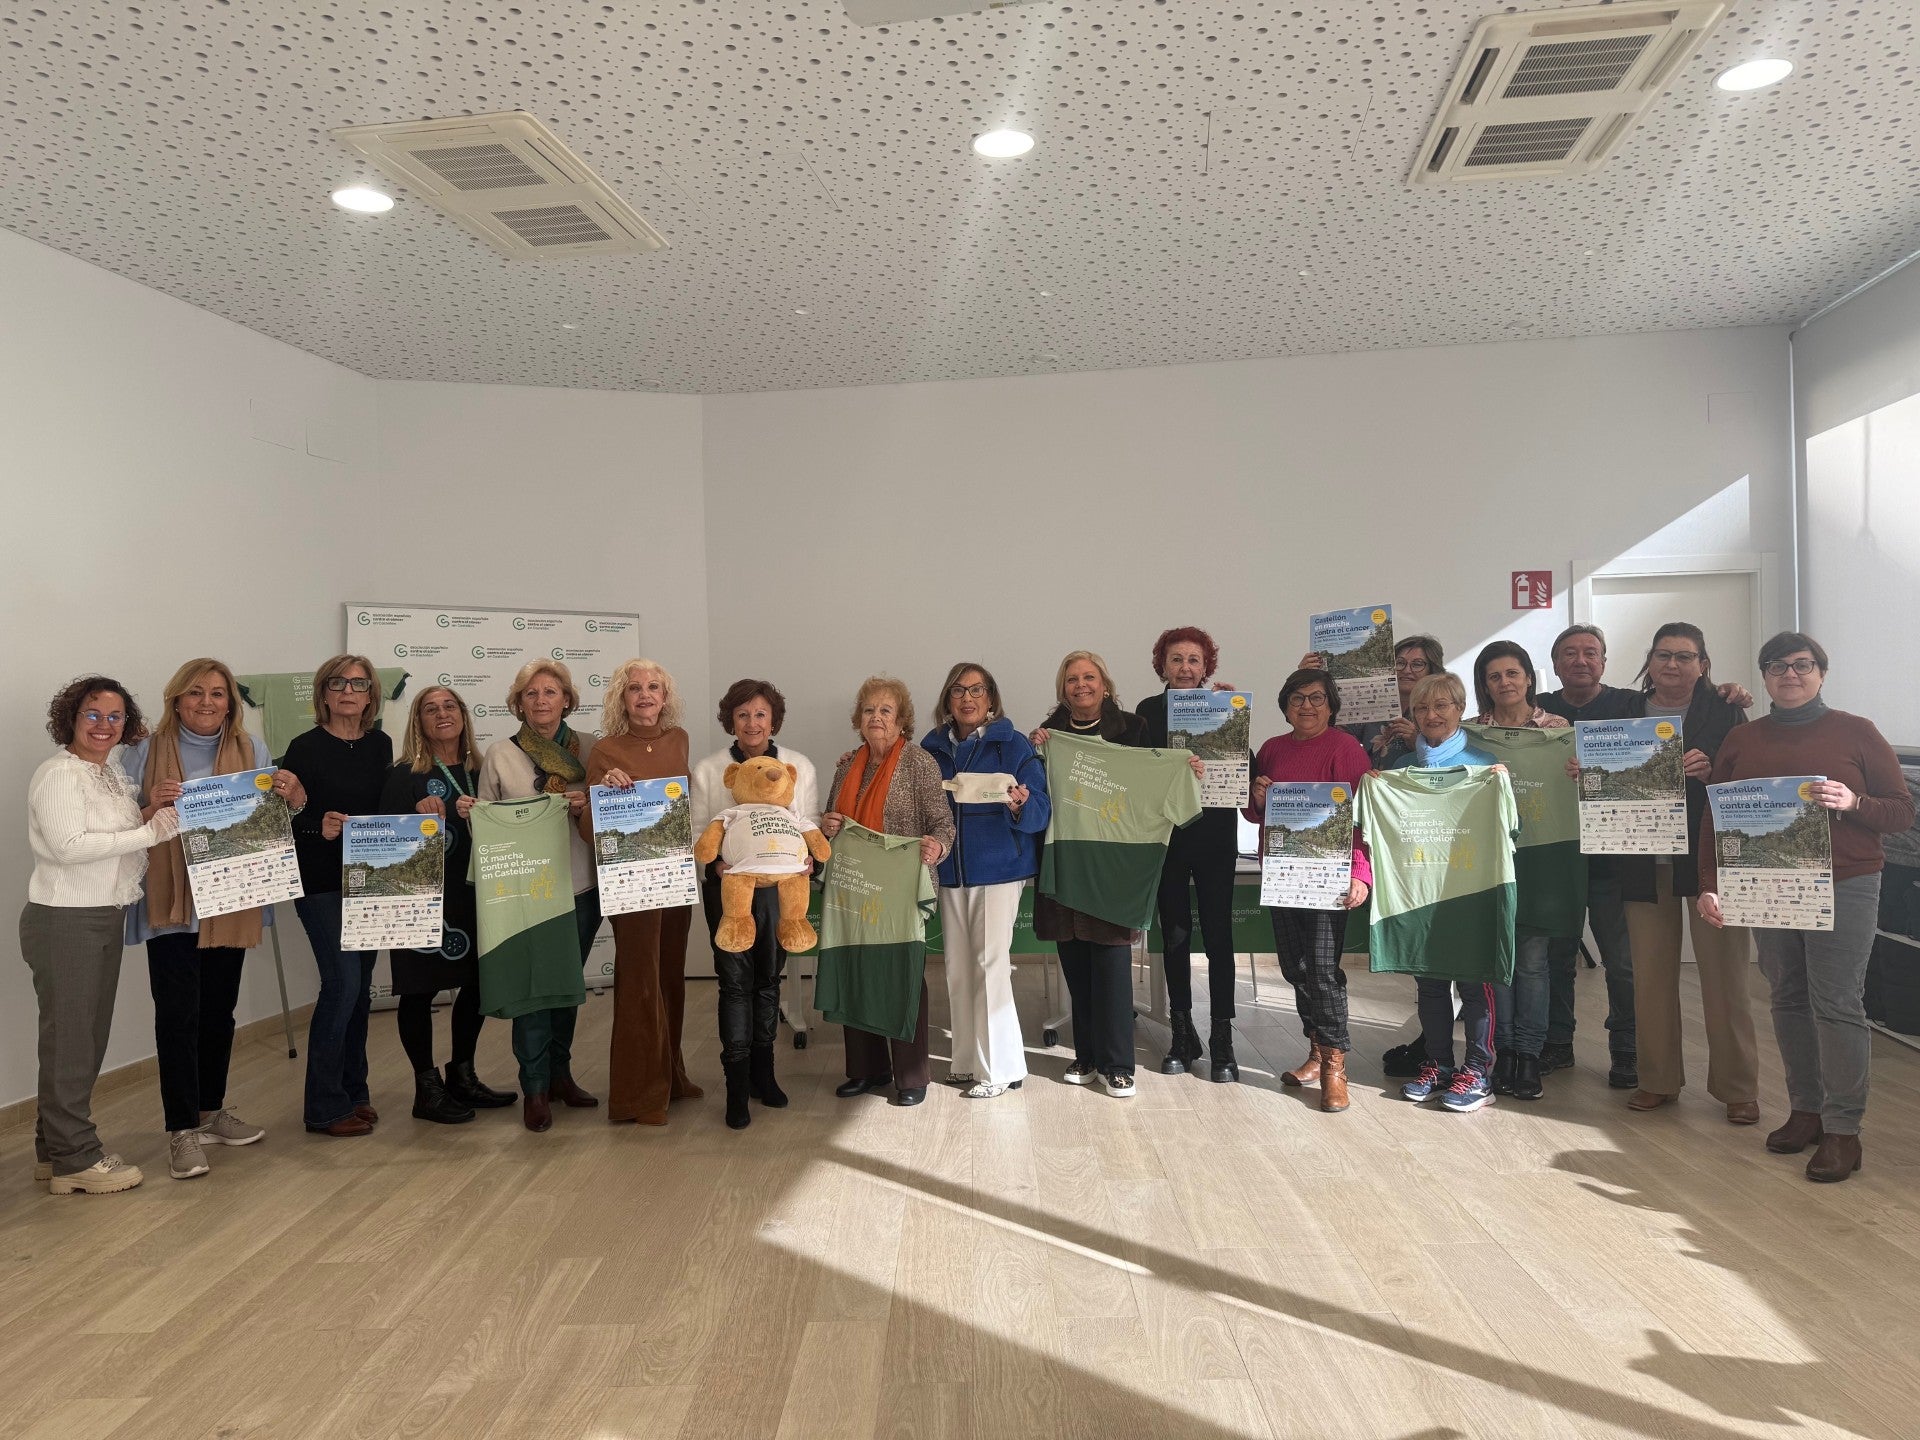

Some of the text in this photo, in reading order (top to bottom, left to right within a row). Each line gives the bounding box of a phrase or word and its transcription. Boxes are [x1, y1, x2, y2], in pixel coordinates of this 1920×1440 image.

[1315, 615, 1346, 624] Castellón
[1324, 621, 1350, 629] marcha
[1583, 725, 1623, 734] Castellón
[1081, 764, 1108, 777] marcha
[1070, 768, 1094, 780] contra
[1103, 779, 1128, 792] cáncer
[1079, 778, 1113, 794] Castellón
[1513, 779, 1543, 788] cáncer
[182, 788, 229, 802] en marcha
[1716, 786, 1762, 794] Castellón
[184, 800, 213, 810] contra
[226, 792, 256, 802] cáncer
[611, 795, 642, 804] marcha
[1720, 801, 1750, 809] contra
[752, 821, 780, 830] contra
[480, 852, 524, 864] IX marcha
[481, 863, 509, 872] contra
[521, 858, 550, 866] cáncer
[494, 866, 535, 878] Castellón
[840, 866, 864, 879] marcha
[831, 872, 851, 883] contra
[860, 880, 883, 892] cáncer
[840, 882, 870, 896] Castellón
